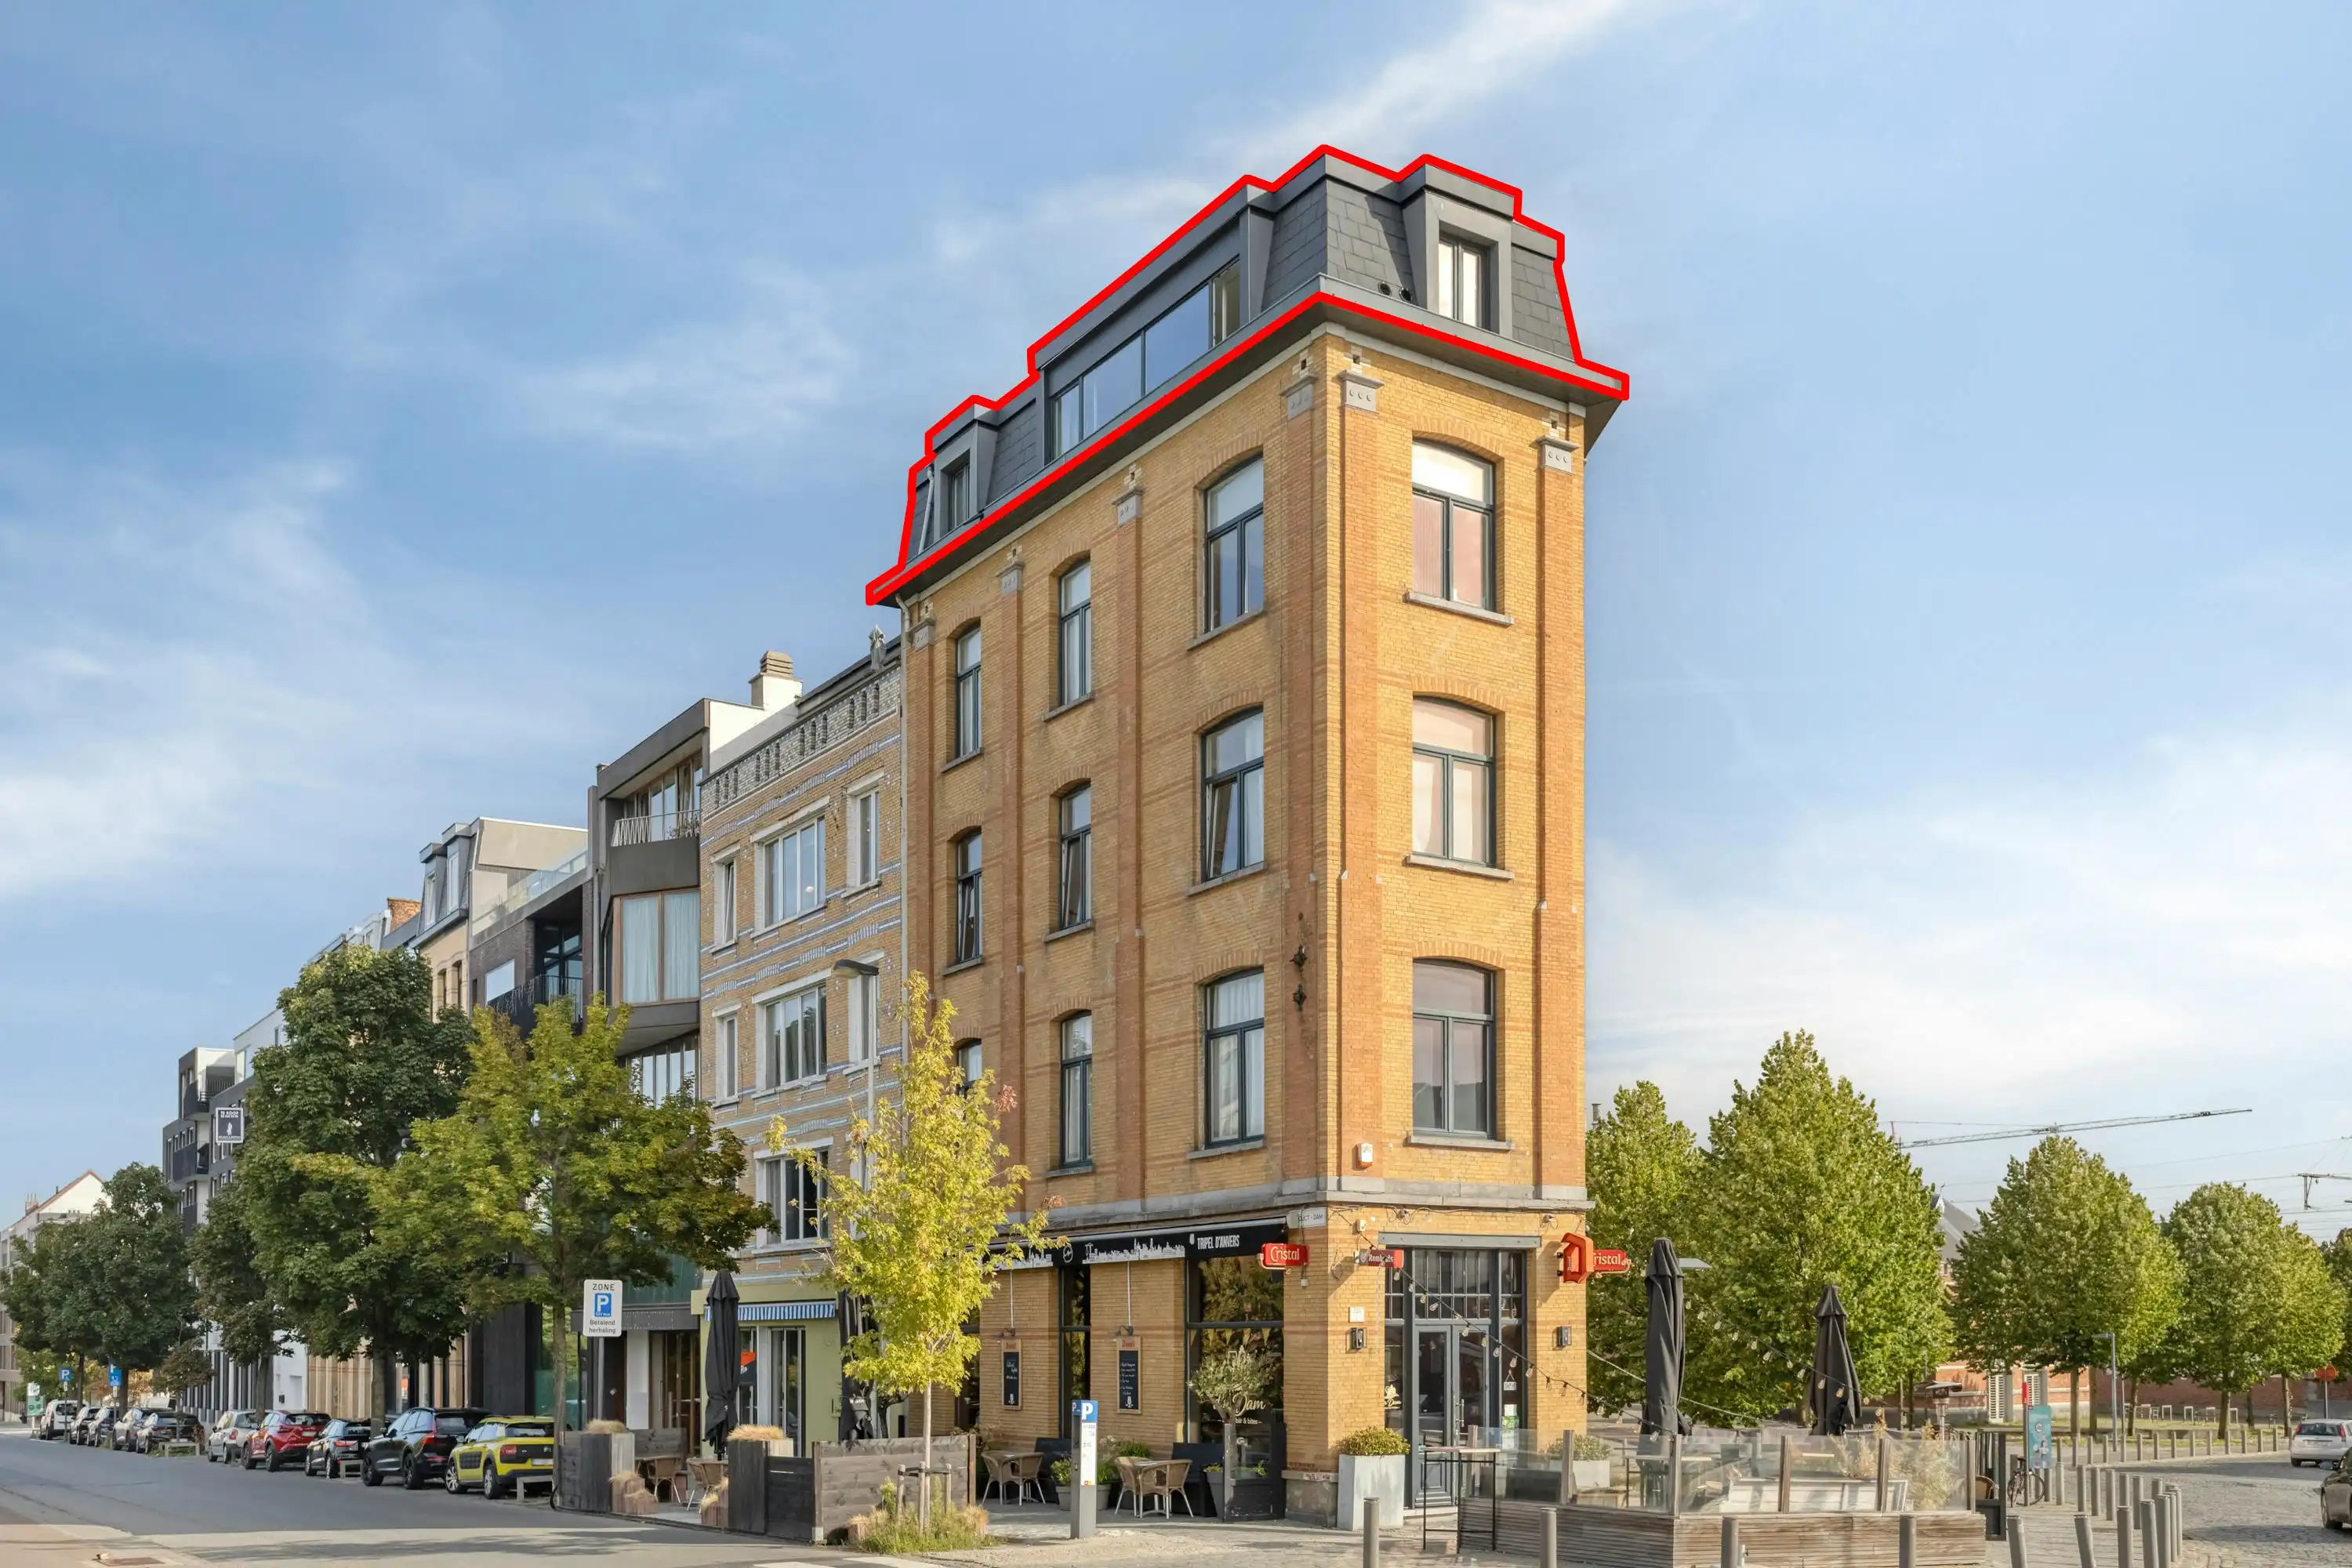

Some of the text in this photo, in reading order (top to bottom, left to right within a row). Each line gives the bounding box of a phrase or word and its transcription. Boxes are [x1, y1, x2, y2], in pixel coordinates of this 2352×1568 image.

[1197, 1235, 1240, 1250] TRIPEL D'ANVERS
[1270, 1246, 1300, 1262] Cristal
[1593, 1253, 1621, 1265] ristal
[597, 1294, 609, 1312] P
[1082, 1403, 1094, 1421] P
